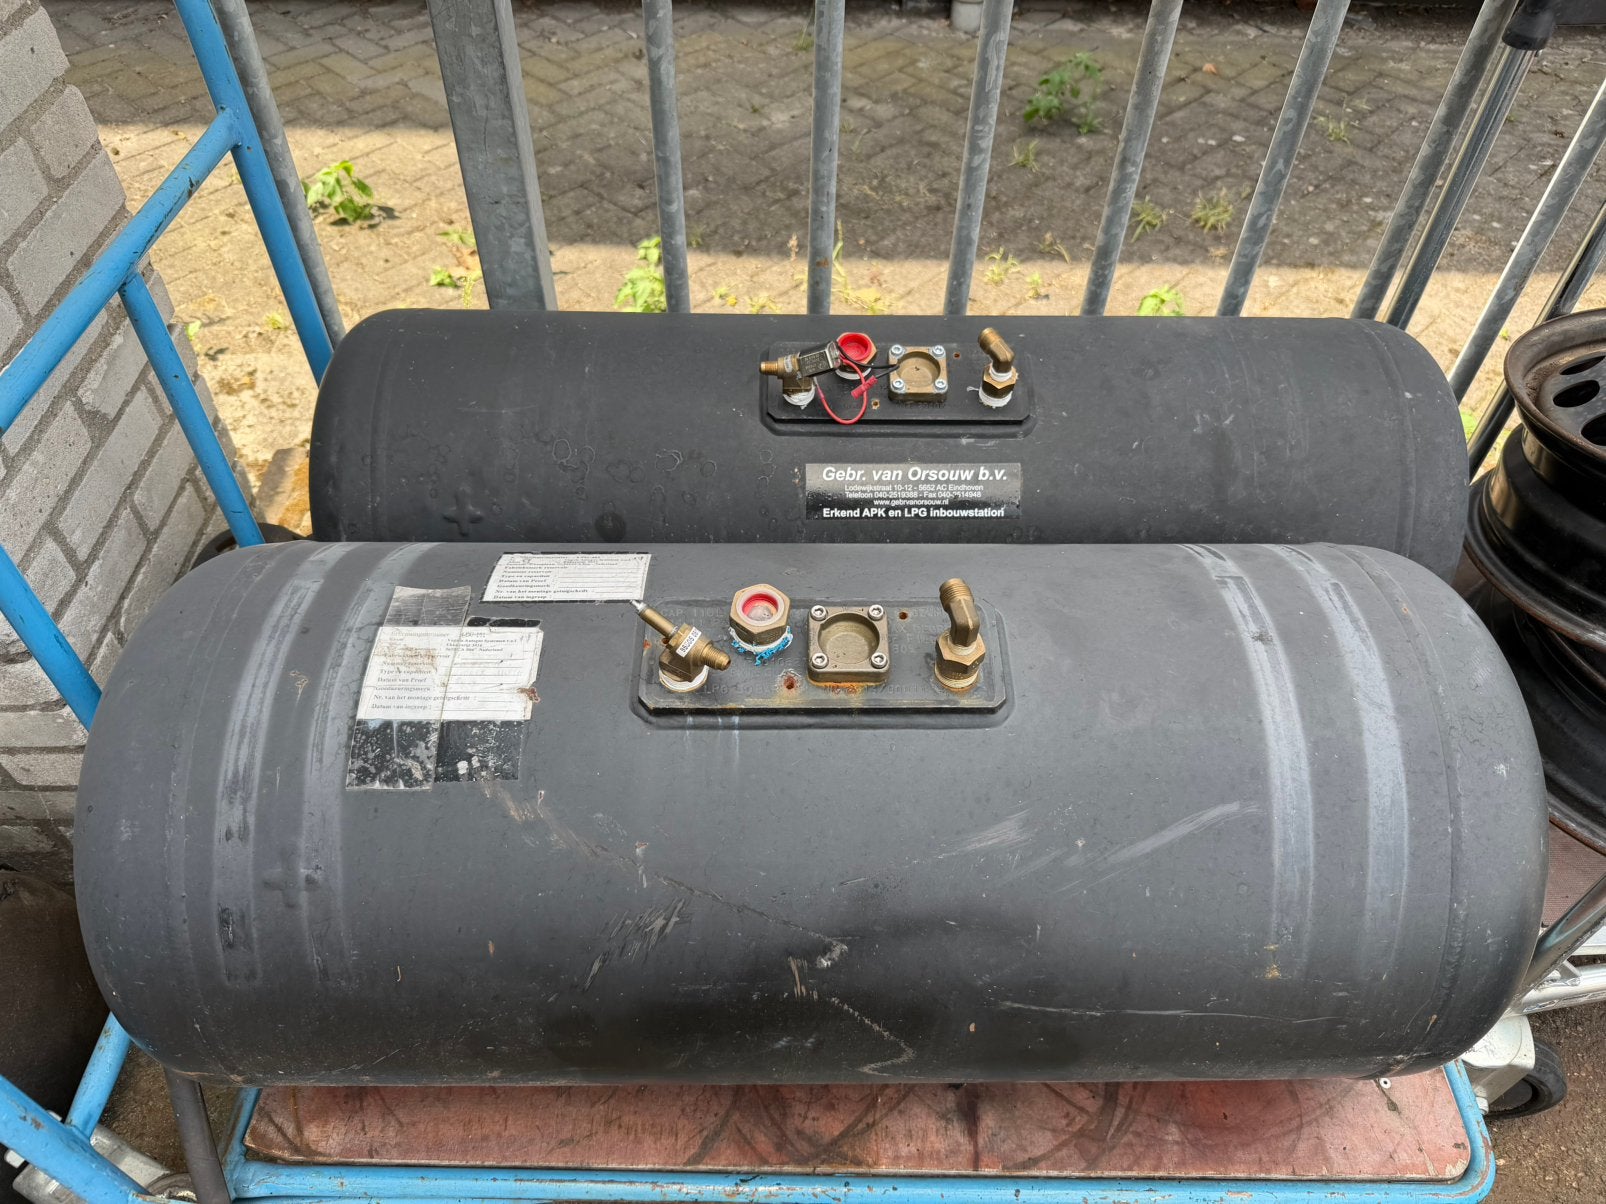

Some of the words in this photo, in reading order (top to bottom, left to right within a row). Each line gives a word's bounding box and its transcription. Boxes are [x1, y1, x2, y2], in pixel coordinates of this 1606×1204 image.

[822, 466, 866, 480] Gebr.
[872, 470, 902, 480] van
[908, 466, 975, 480] Orsouw
[978, 466, 1007, 480] b.v.
[823, 508, 860, 517] Erkend
[862, 508, 886, 517] APK
[904, 508, 927, 517] LPG
[930, 507, 1004, 517] inbouwstation
